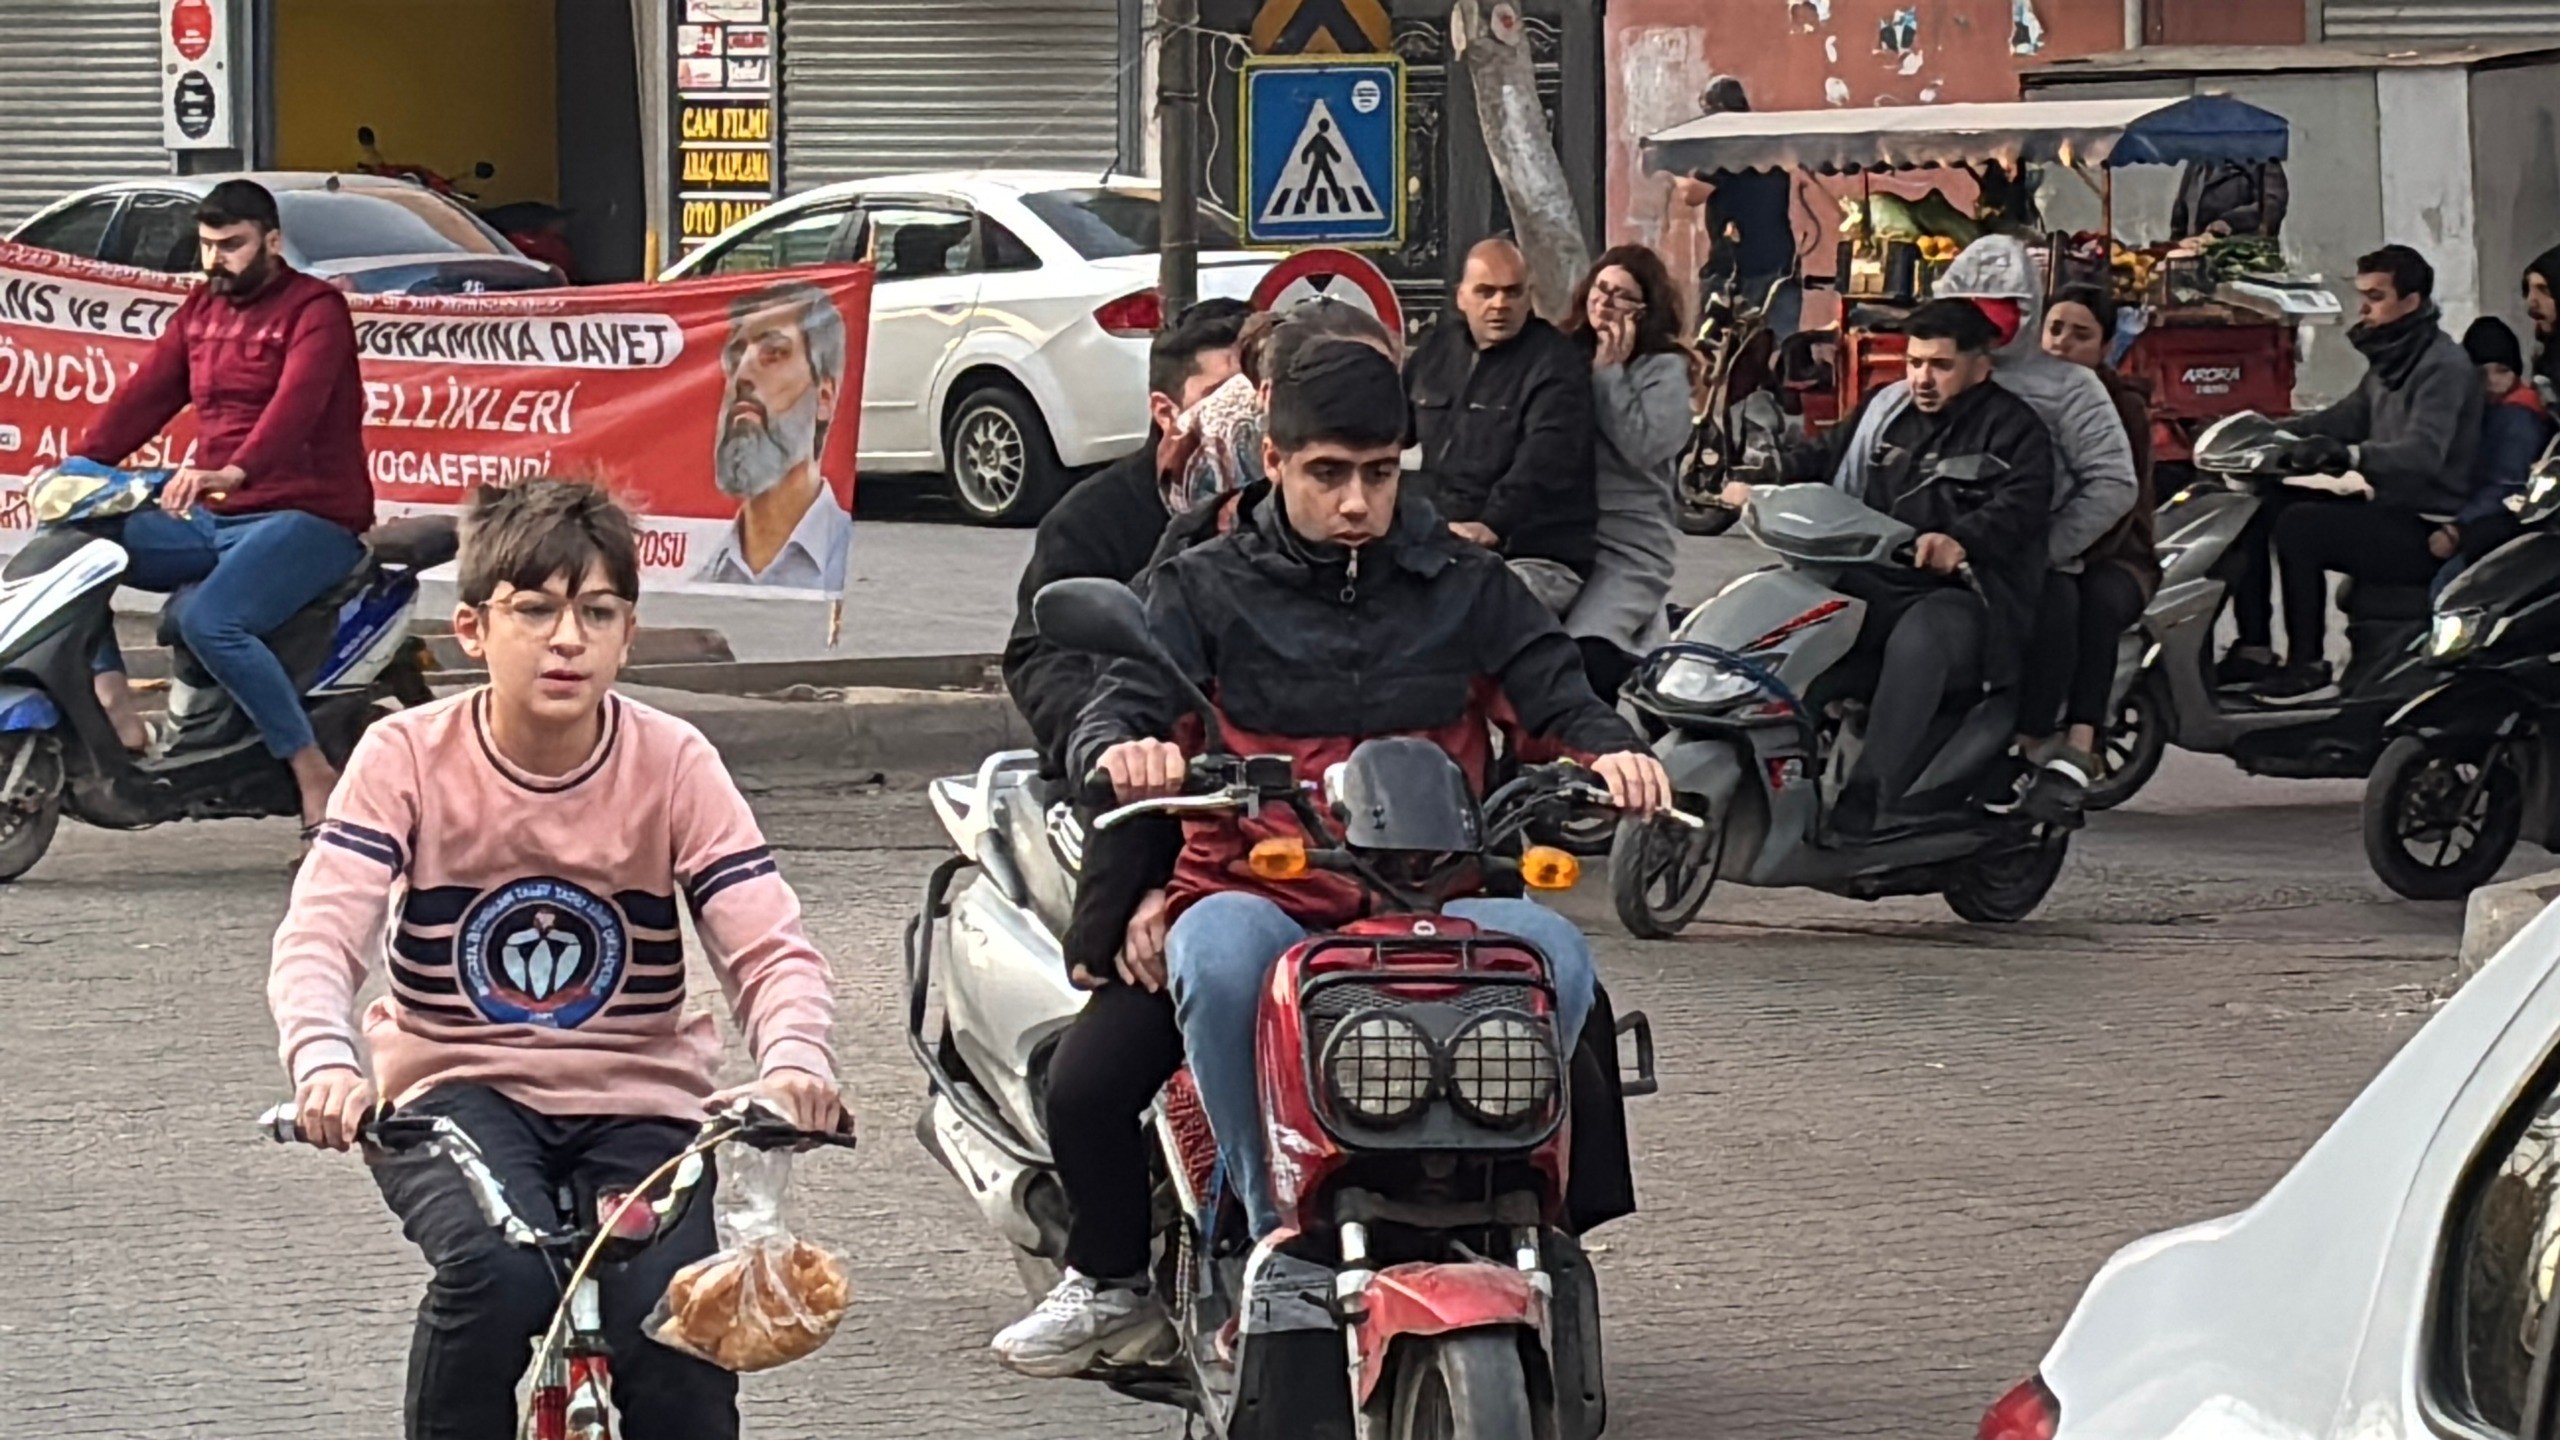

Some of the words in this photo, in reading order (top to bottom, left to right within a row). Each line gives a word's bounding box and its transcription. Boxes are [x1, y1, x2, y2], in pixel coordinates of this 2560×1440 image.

[682, 107, 719, 138] CAM
[683, 200, 716, 235] OTO
[69, 297, 109, 331] ve
[550, 320, 669, 365] DAVET
